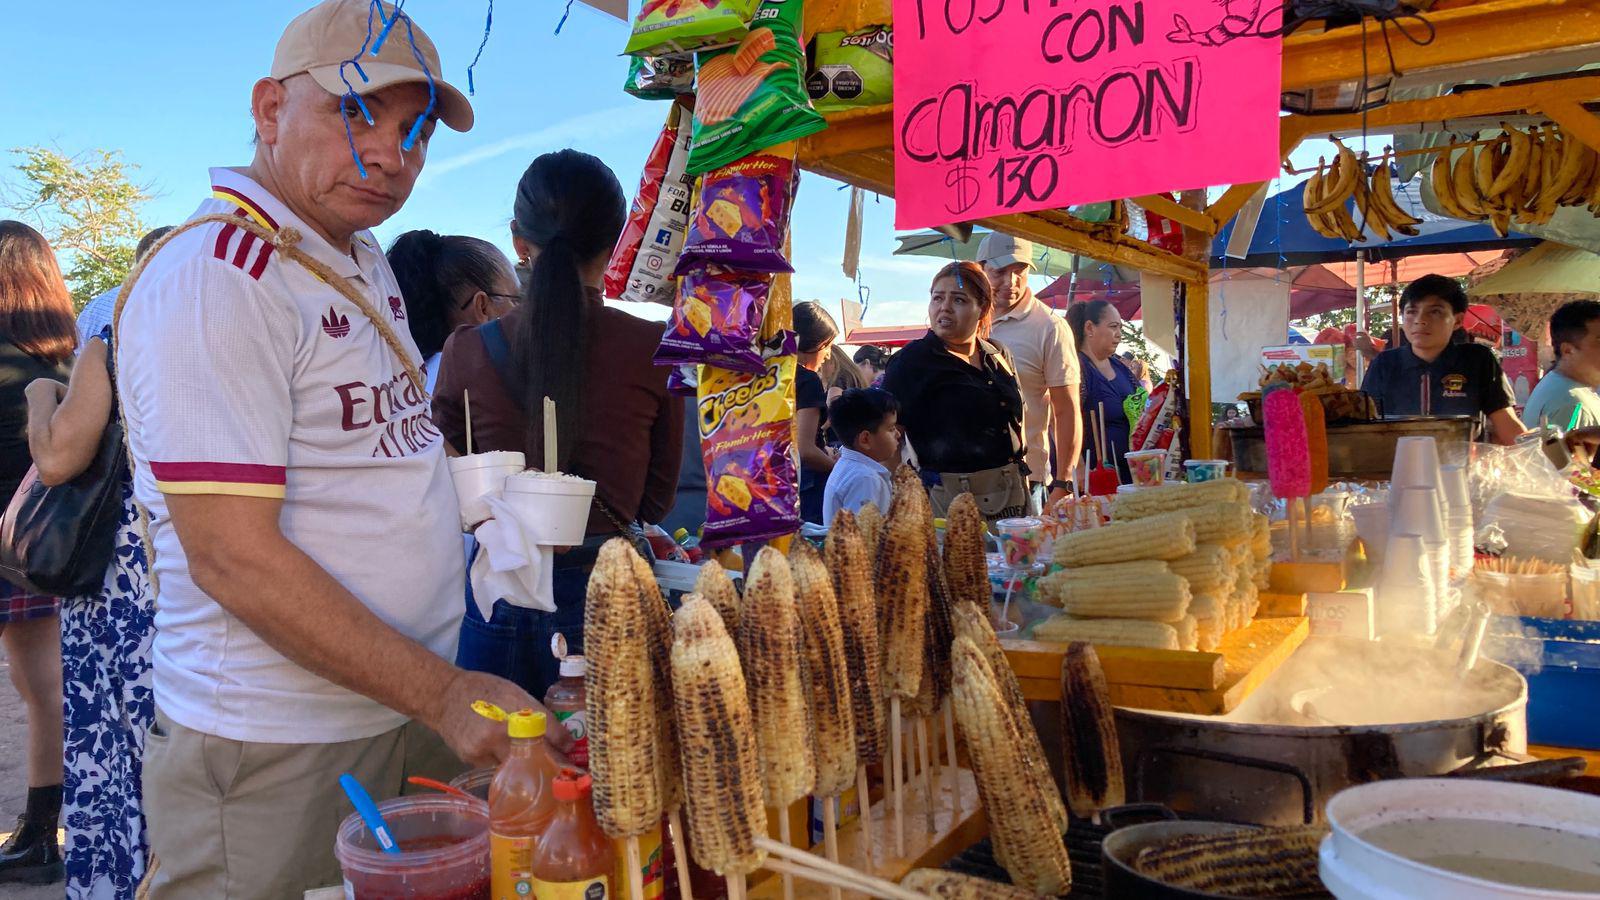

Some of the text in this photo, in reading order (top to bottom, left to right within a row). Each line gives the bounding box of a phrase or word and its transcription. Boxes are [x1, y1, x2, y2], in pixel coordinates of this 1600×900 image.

[1041, 1, 1144, 62] CON
[667, 186, 686, 199] FOR
[698, 364, 779, 439] Cheetos
